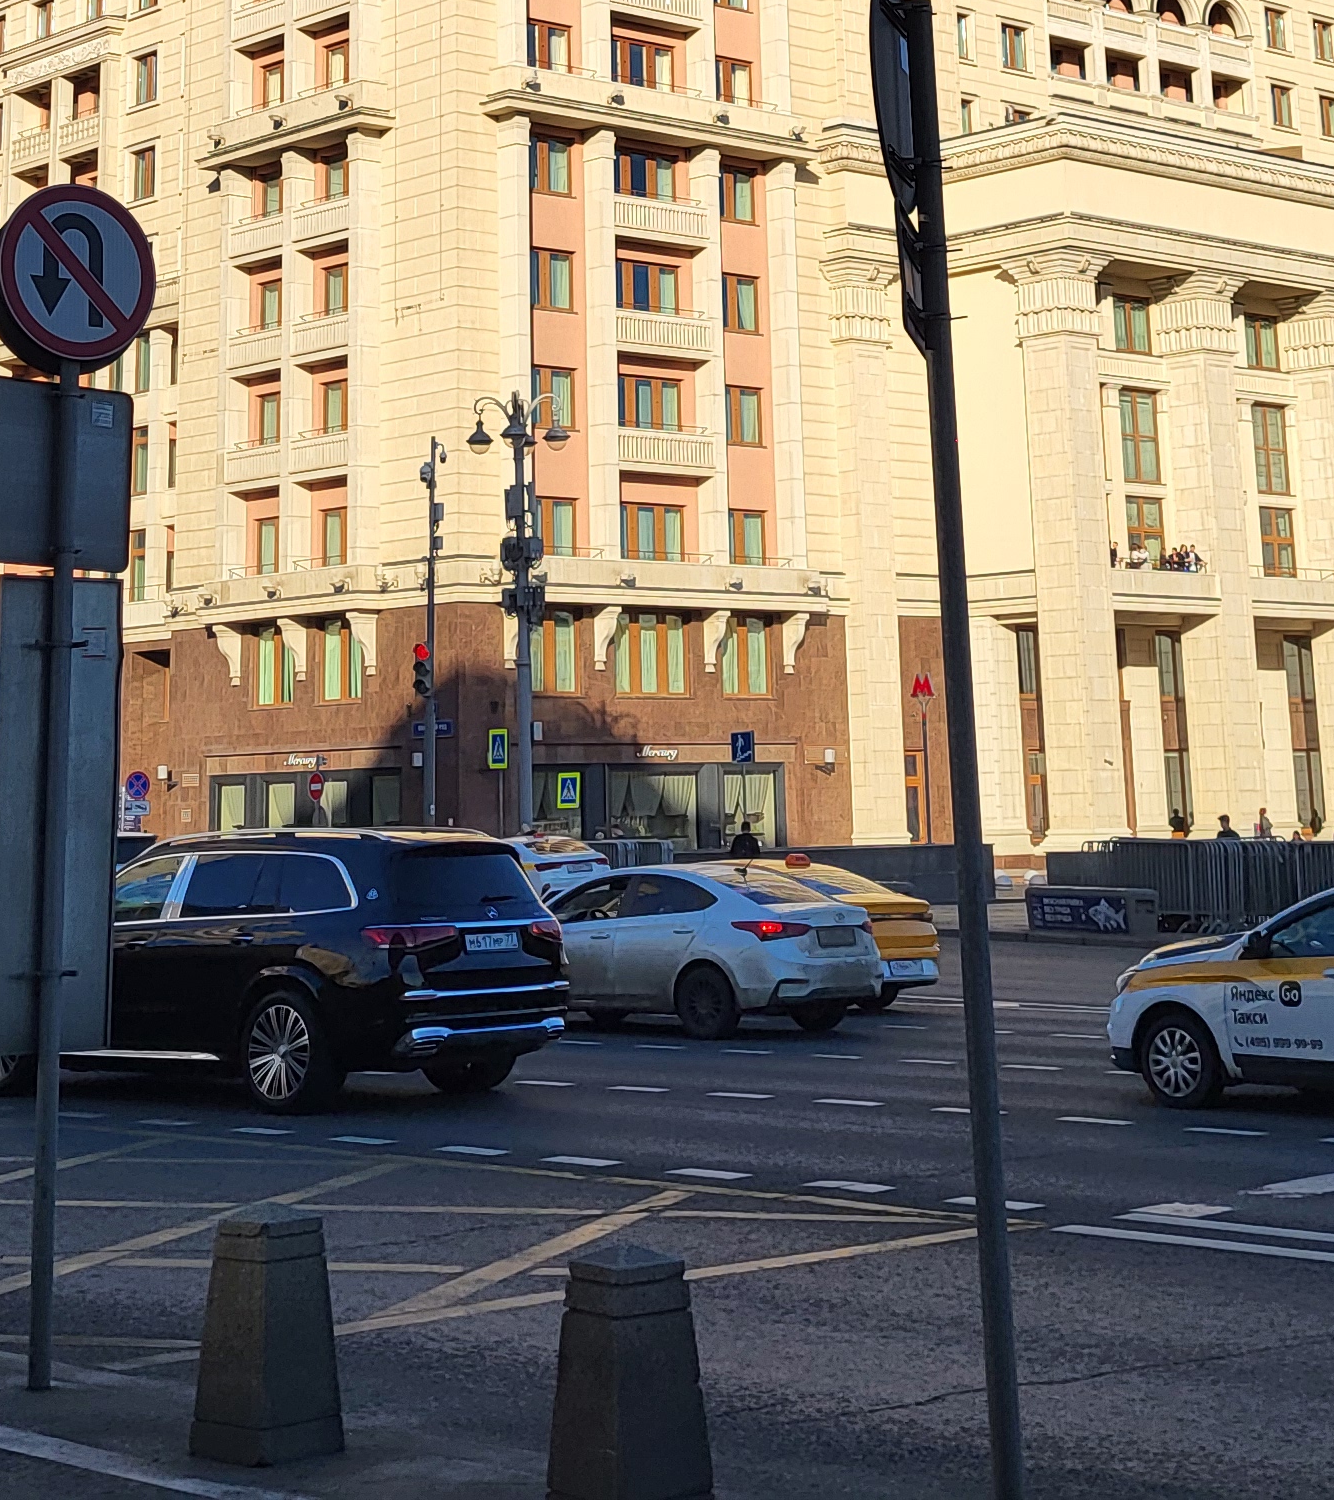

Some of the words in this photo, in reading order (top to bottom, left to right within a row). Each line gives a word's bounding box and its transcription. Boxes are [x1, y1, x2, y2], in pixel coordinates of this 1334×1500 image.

[1230, 985, 1275, 1003] Яндекс
[1281, 985, 1299, 1002] Go
[1231, 1008, 1269, 1025] Такси
